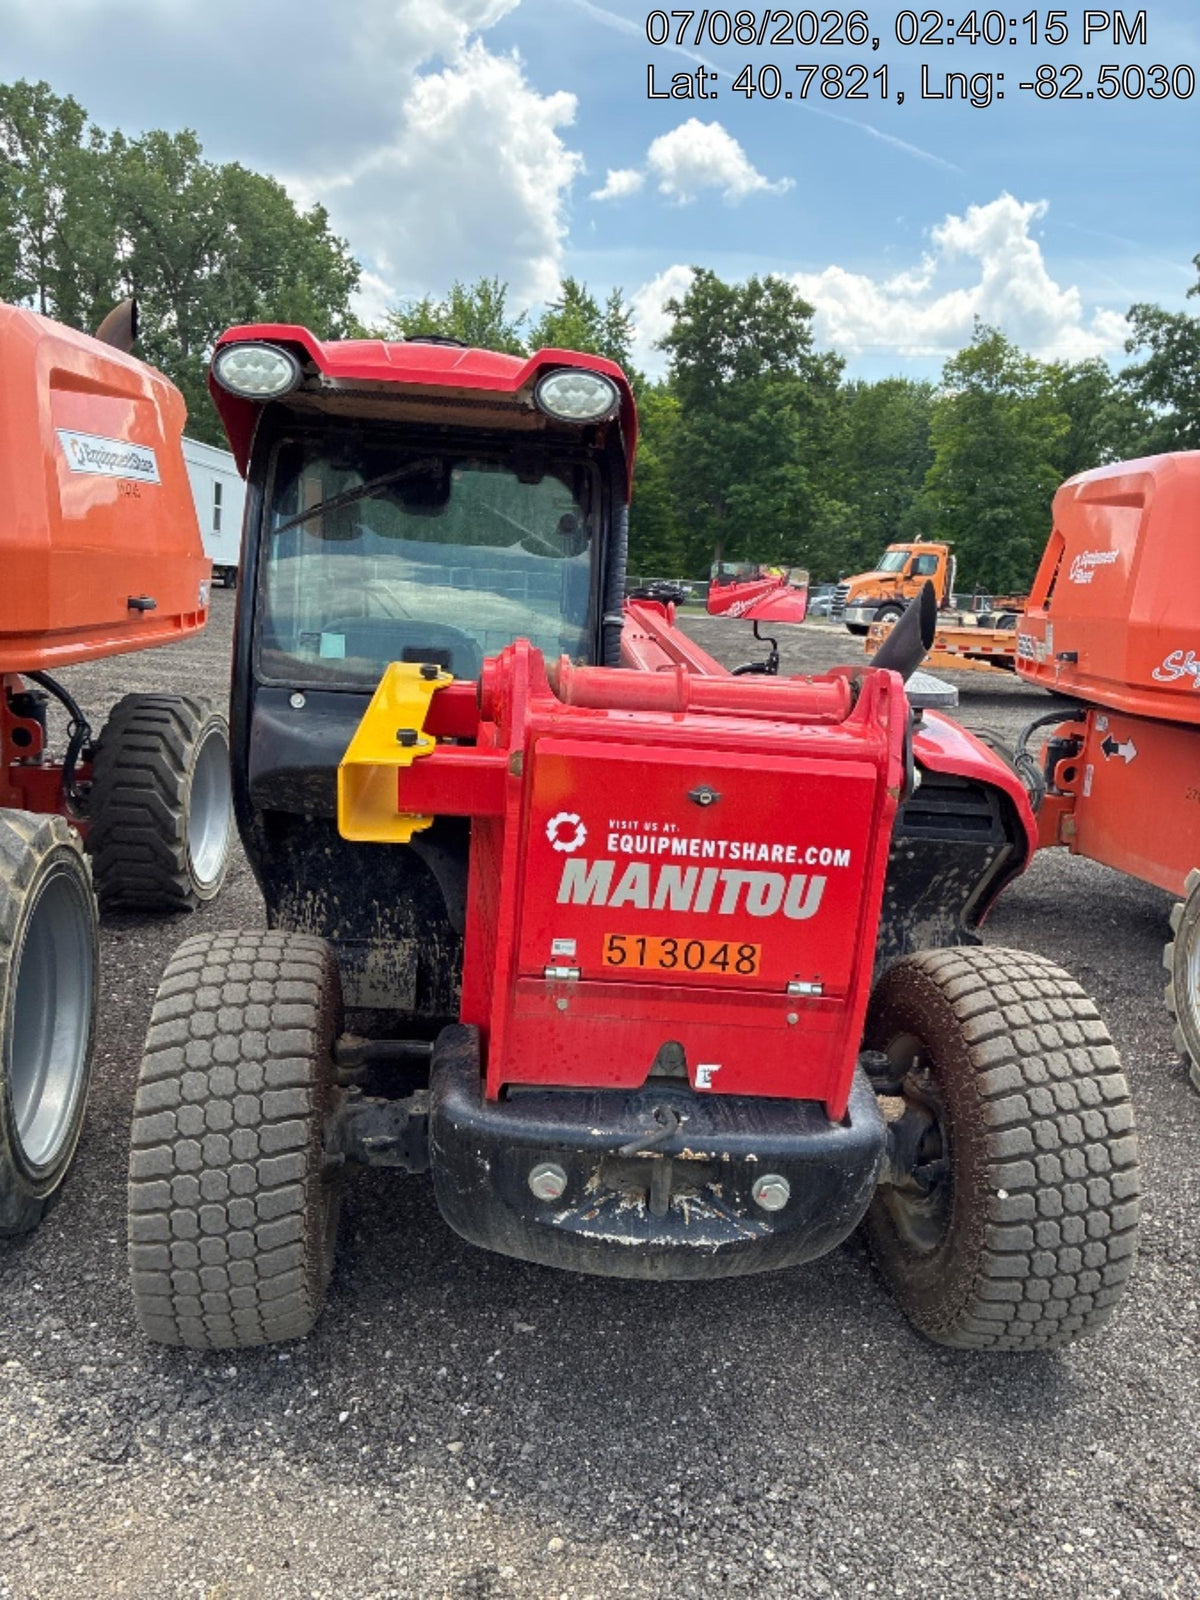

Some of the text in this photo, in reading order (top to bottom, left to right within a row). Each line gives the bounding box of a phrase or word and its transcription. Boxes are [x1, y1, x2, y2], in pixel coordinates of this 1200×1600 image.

[608, 819, 638, 830] VISIT
[643, 821, 658, 831] US
[607, 833, 852, 867] EQUIPMENTSHARE.COM
[556, 858, 827, 920] MANITOU
[606, 934, 758, 975] 513048
